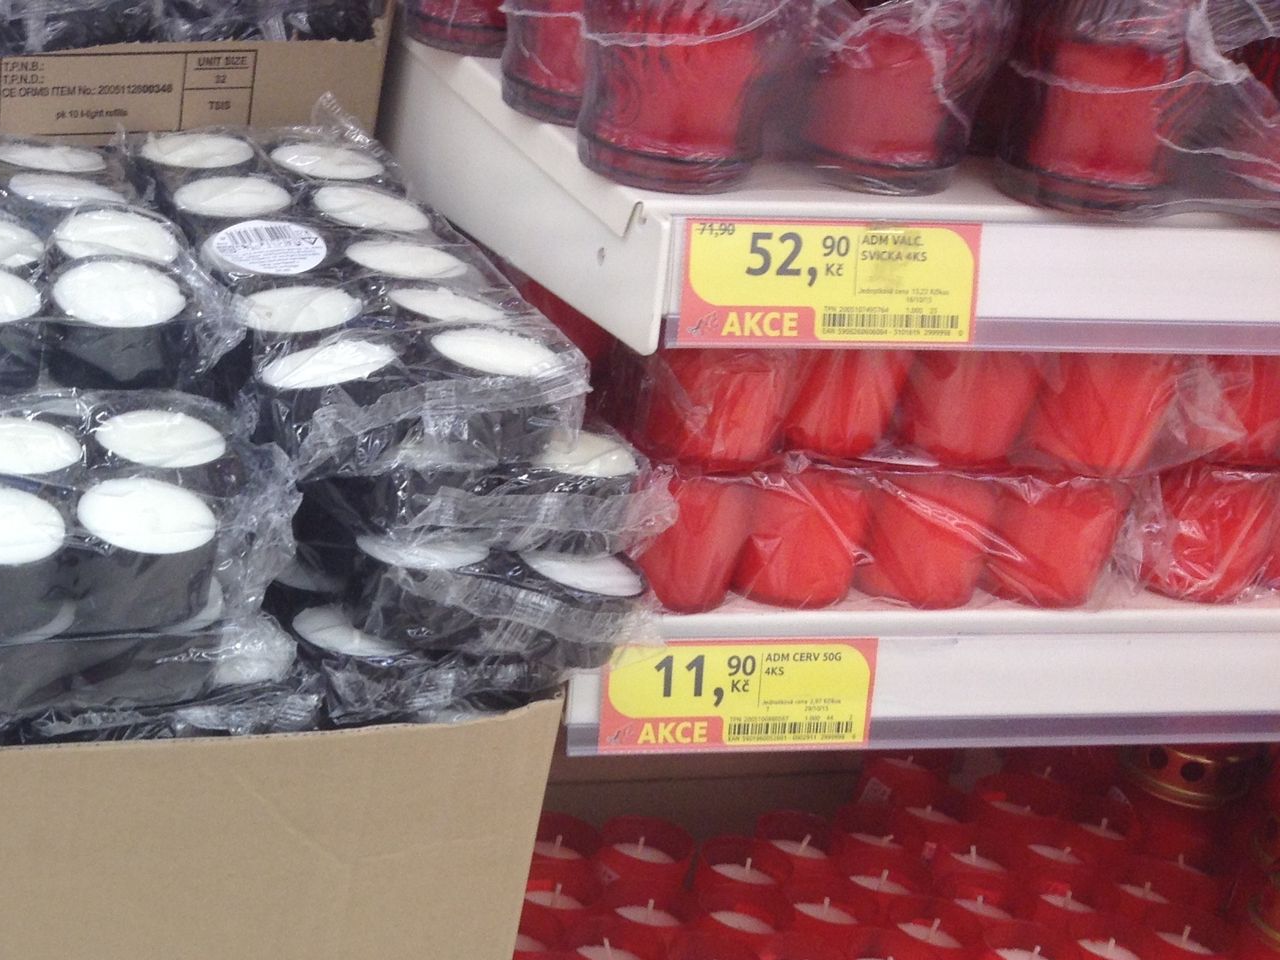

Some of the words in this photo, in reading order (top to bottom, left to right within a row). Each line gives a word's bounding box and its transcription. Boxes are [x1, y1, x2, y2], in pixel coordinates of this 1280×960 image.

[198, 57, 221, 66] UNIT
[52, 86, 76, 96] ITEM
[862, 235, 889, 246] ADM
[825, 264, 844, 277] Kč
[722, 311, 799, 337] AKCE
[765, 653, 790, 662] ADM
[793, 652, 819, 662] CERV
[823, 652, 842, 662] 50G
[765, 667, 785, 676] 4KS
[731, 679, 750, 693] Kč
[637, 722, 708, 744] AKCE
